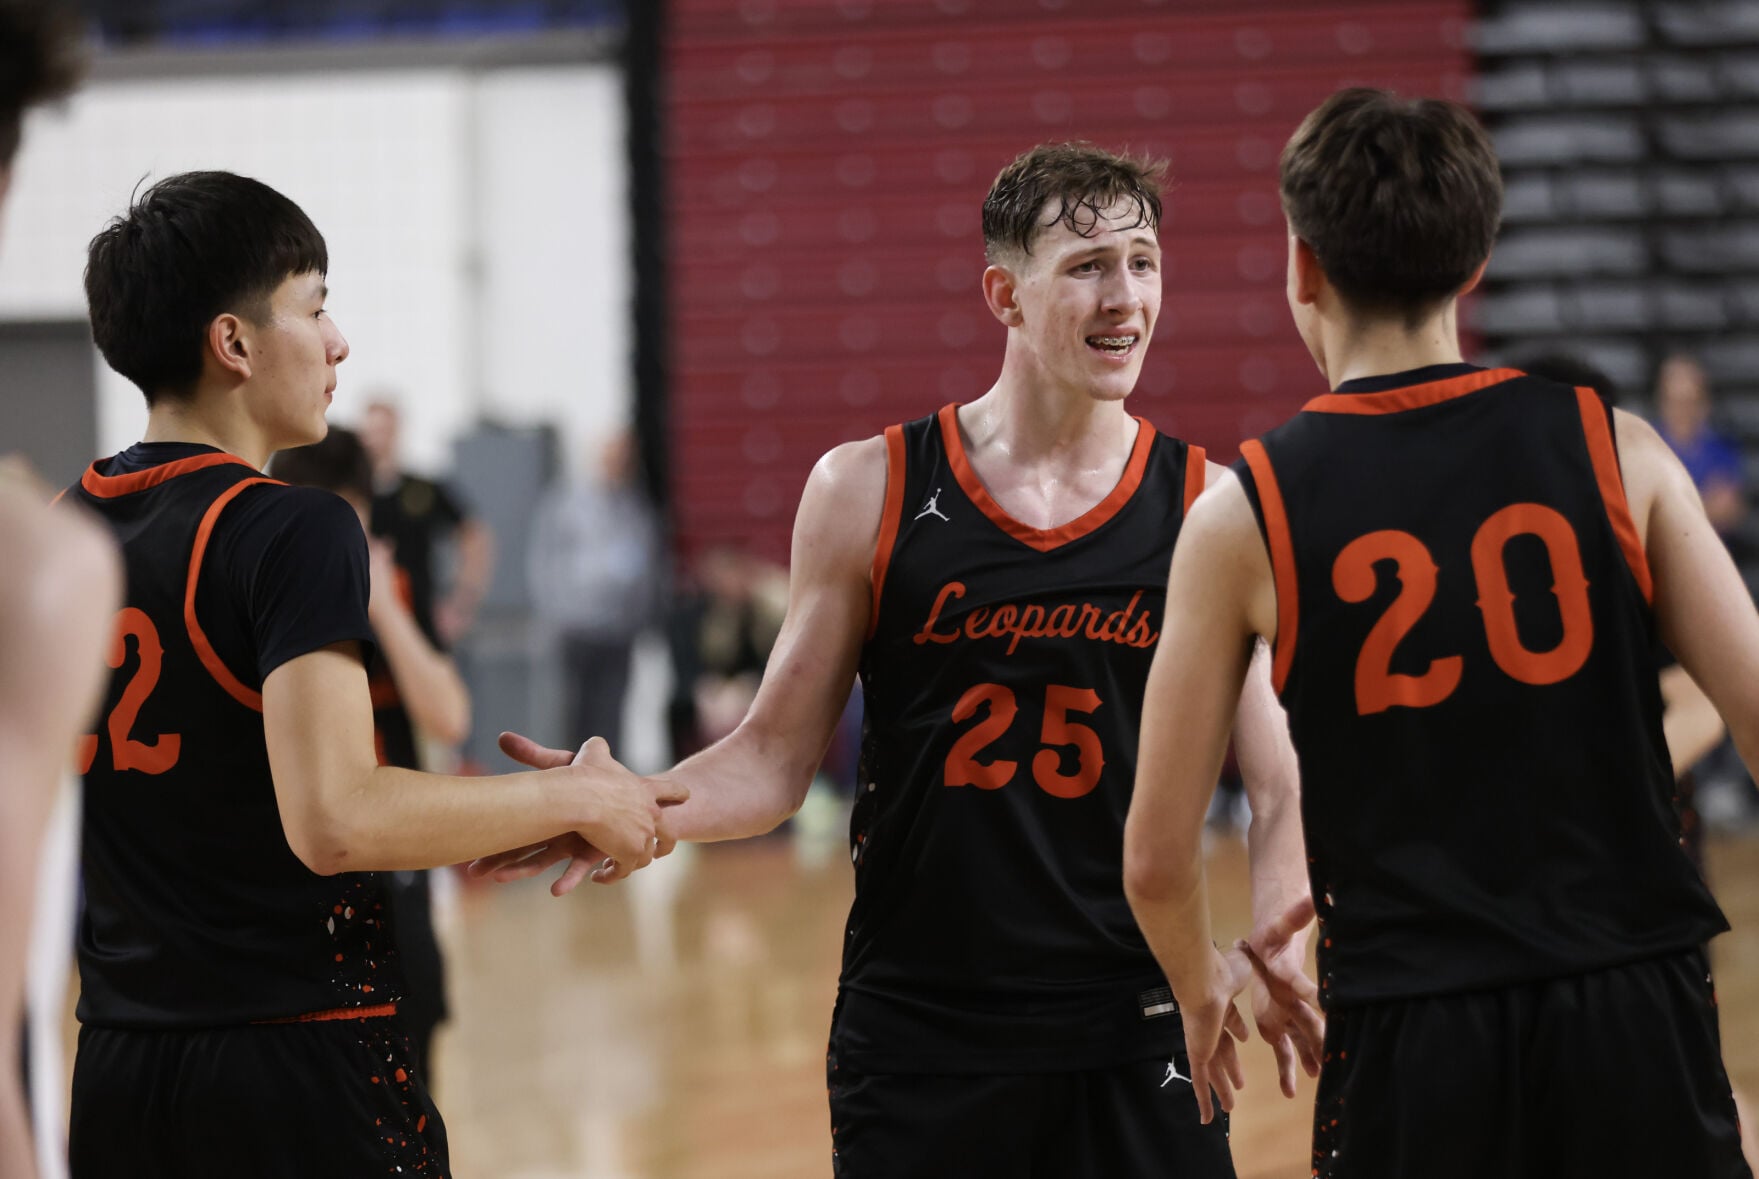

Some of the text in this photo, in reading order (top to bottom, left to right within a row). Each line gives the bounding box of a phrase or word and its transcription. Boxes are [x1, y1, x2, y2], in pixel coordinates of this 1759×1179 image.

[913, 581, 1159, 655] Leopards
[1332, 503, 1593, 715] 20
[75, 607, 181, 775] 2
[944, 683, 1106, 799] 25
